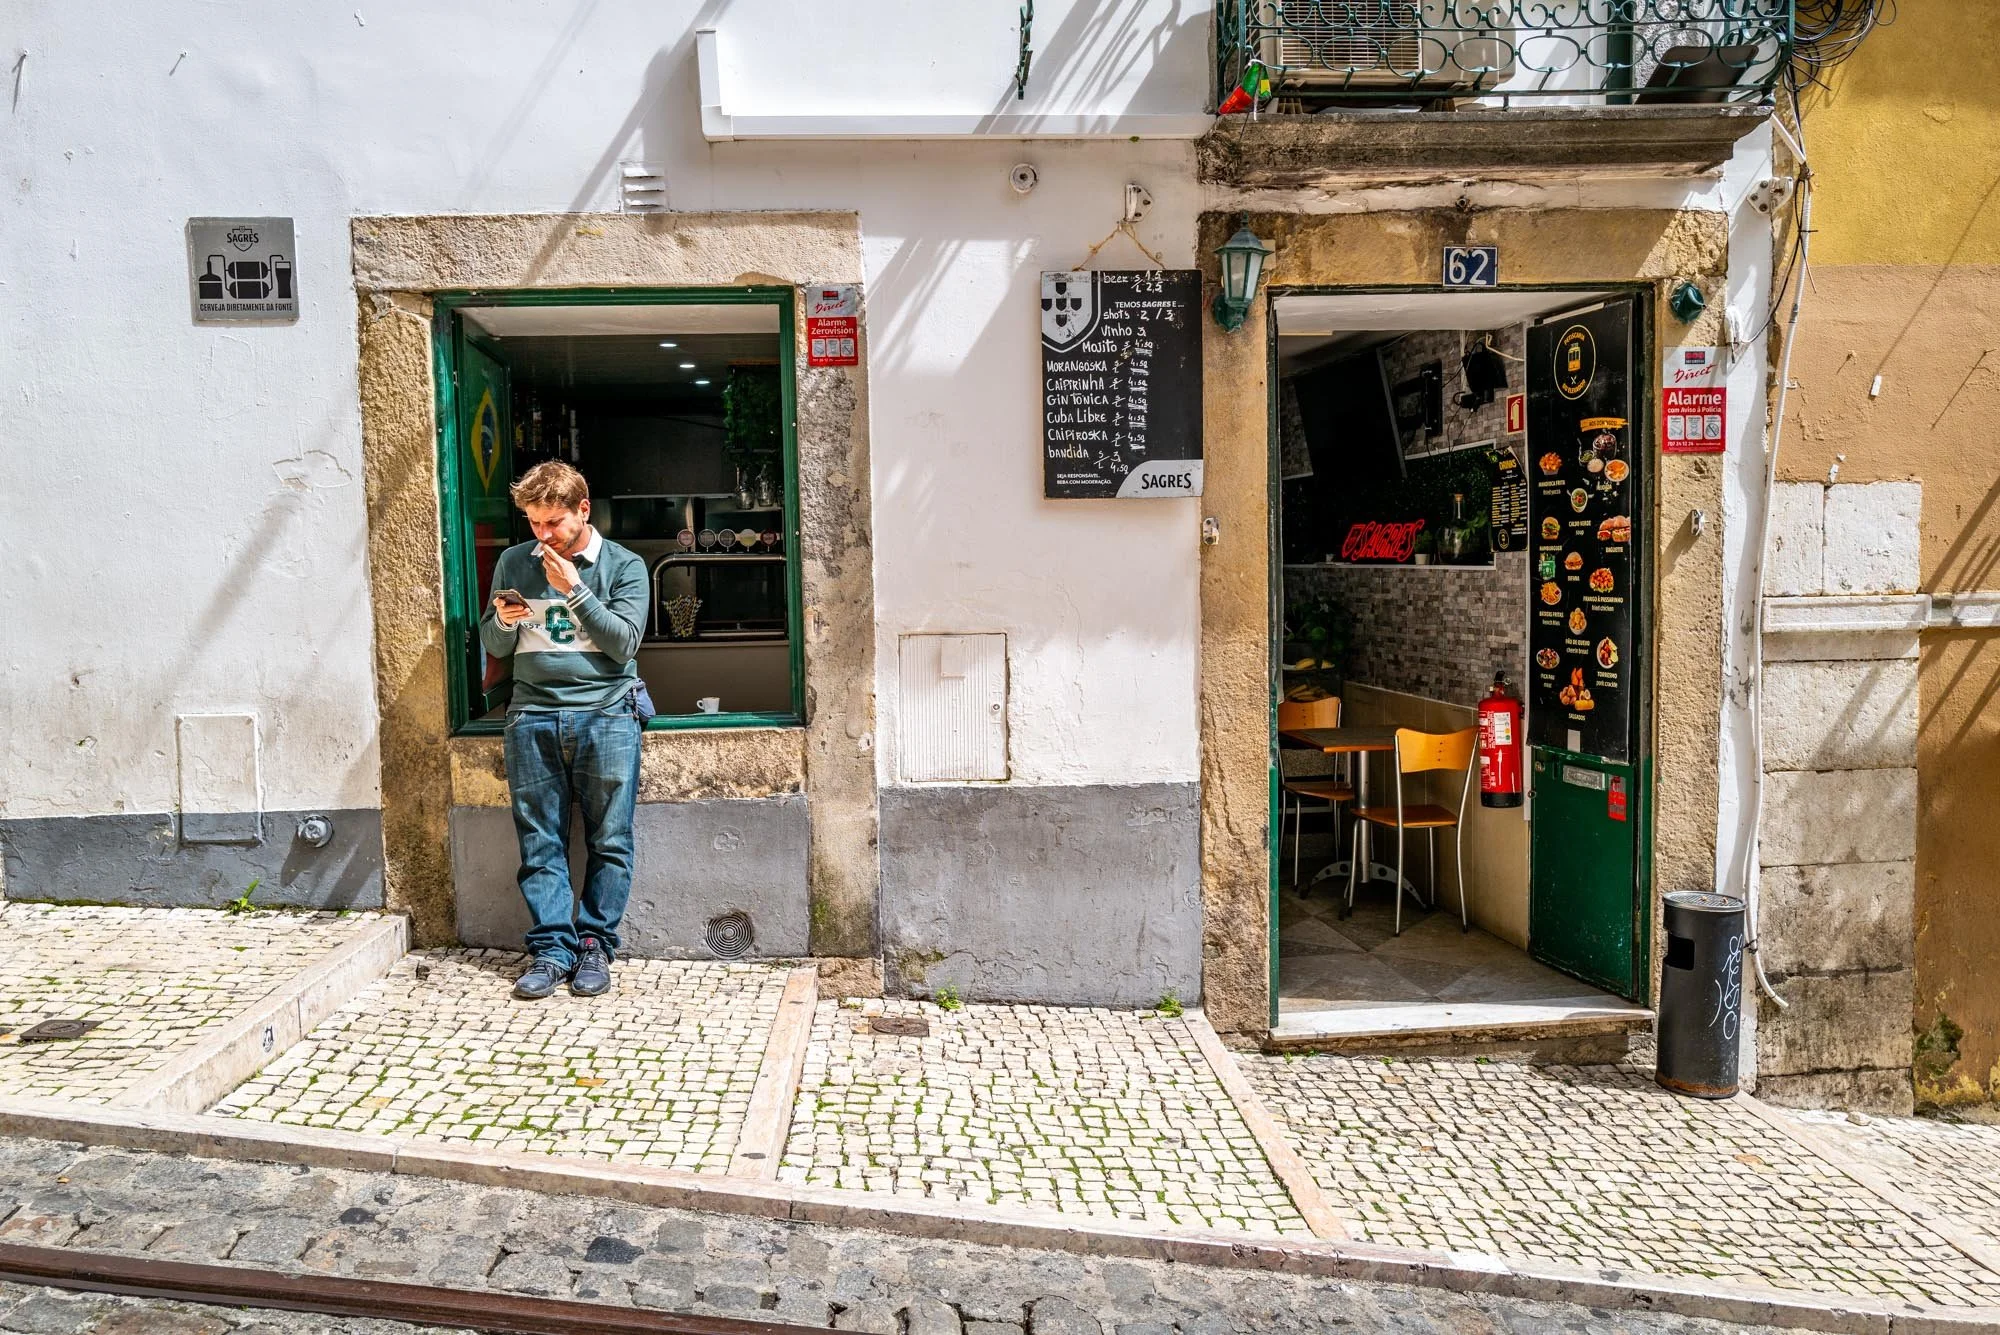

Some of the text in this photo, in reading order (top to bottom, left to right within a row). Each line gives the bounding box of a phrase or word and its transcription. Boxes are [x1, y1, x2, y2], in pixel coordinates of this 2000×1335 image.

[227, 233, 259, 243] SAGRES
[1449, 249, 1488, 284] 62
[200, 303, 225, 311] CERVEJA
[227, 303, 264, 311] DIRETAMENTE
[815, 299, 847, 314] Direct
[818, 319, 846, 327] Alarme
[1101, 322, 1132, 336] Vinho
[1082, 339, 1117, 352] Mojito
[1674, 364, 1717, 383] Direct
[1668, 391, 1721, 406] Alarme
[1142, 473, 1191, 489] SAGRES
